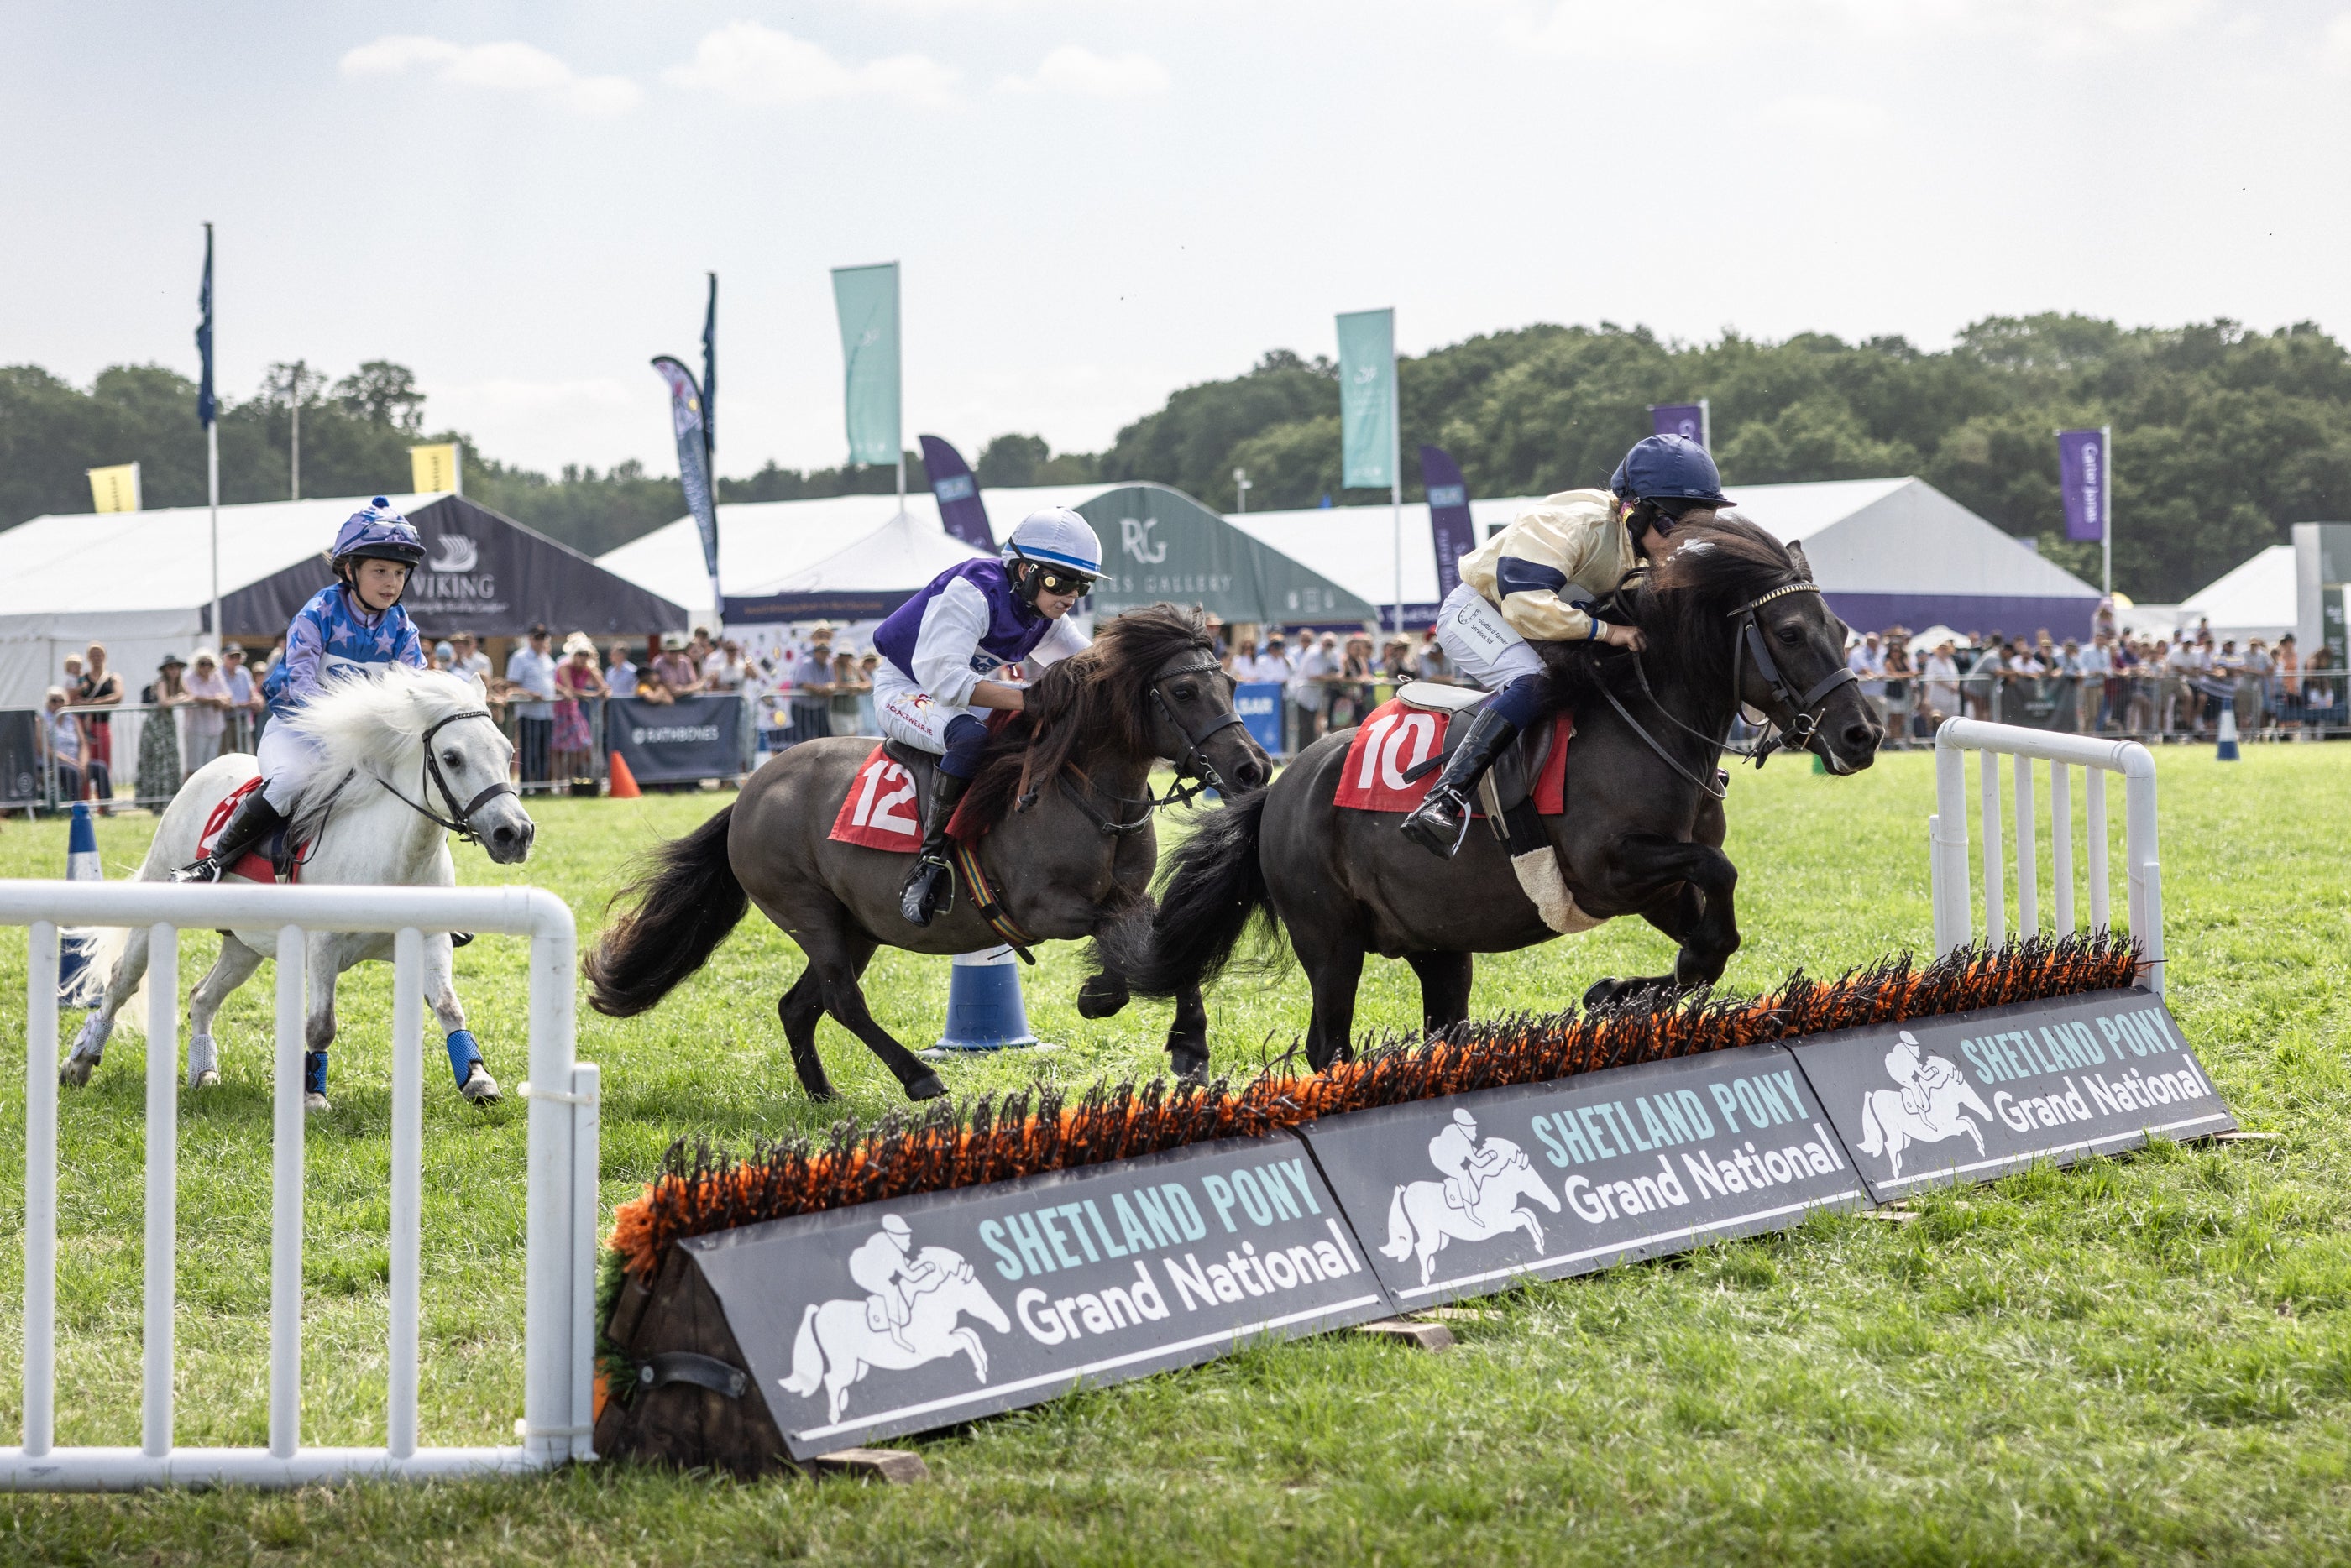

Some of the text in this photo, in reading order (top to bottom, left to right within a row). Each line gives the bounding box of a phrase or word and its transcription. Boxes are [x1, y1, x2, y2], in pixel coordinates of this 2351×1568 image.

[2081, 442, 2098, 524] Carter Jonas
[1119, 517, 1169, 564] RG
[411, 573, 495, 598] VIKING
[1093, 574, 1134, 593] LES
[1144, 574, 1232, 593] GALLERY
[1471, 624, 1486, 640] Services
[1479, 618, 1509, 645] Goddard Farrier
[647, 725, 719, 743] RATHBONES
[1357, 713, 1436, 791] 10
[851, 759, 918, 837] 12
[1961, 1007, 2179, 1085] SHETLAND PONY
[1531, 1069, 1809, 1168] SHETLAND PONY
[1993, 1053, 2212, 1133] Grand National
[1564, 1122, 1846, 1224] Grand National
[978, 1158, 1322, 1281] SHETLAND PONY
[1015, 1218, 1362, 1345] Grand National
